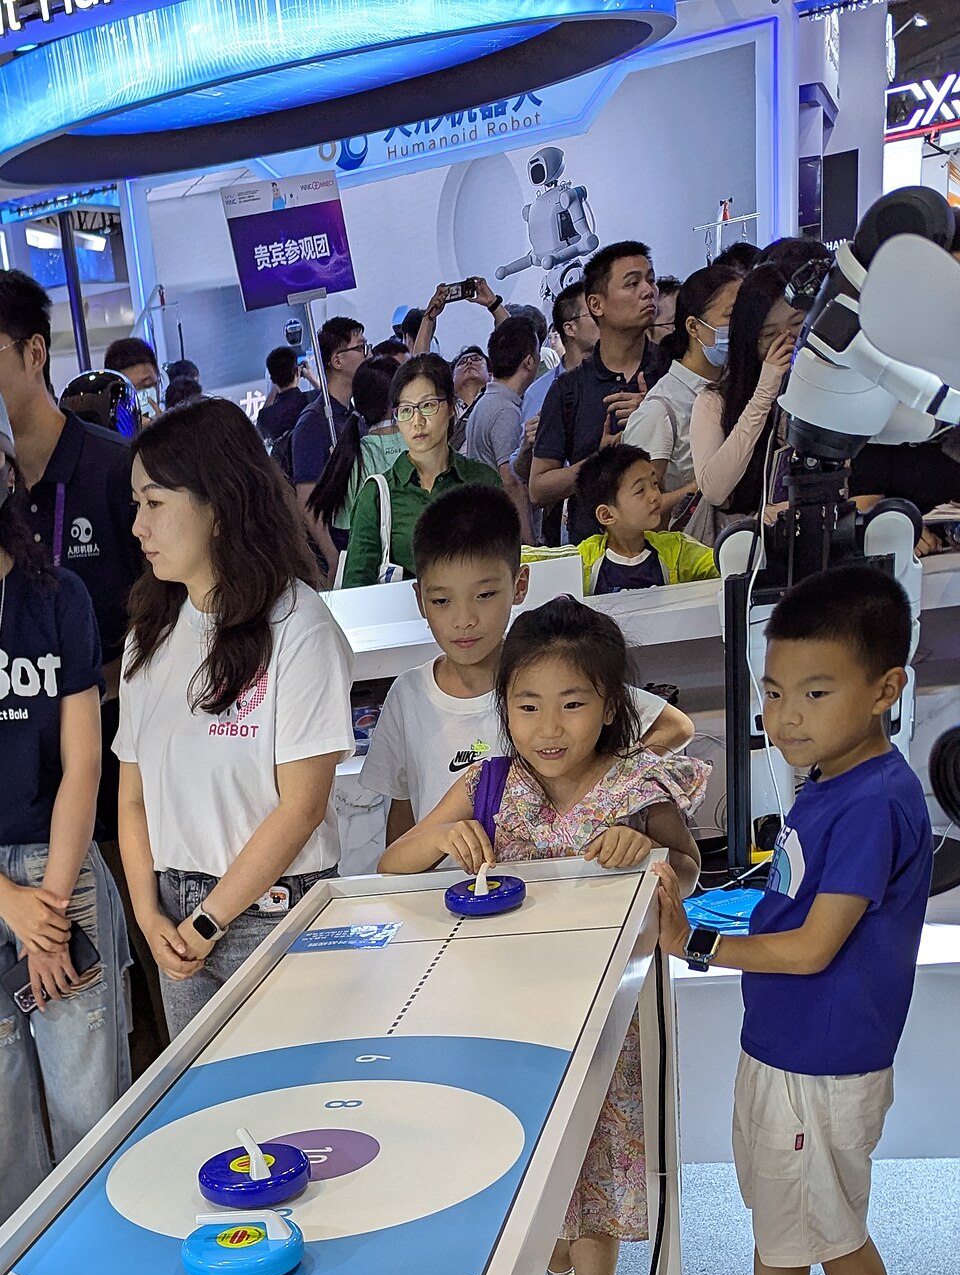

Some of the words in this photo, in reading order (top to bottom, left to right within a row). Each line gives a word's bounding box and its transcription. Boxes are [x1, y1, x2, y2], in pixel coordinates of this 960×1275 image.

[883, 73, 960, 134] CX
[387, 127, 478, 160] Humanoid
[487, 113, 541, 137] Robot
[254, 233, 331, 271] 贵宾参观团
[9, 708, 29, 720] Bold
[454, 750, 477, 763] NIKE
[324, 1099, 363, 1109] 8
